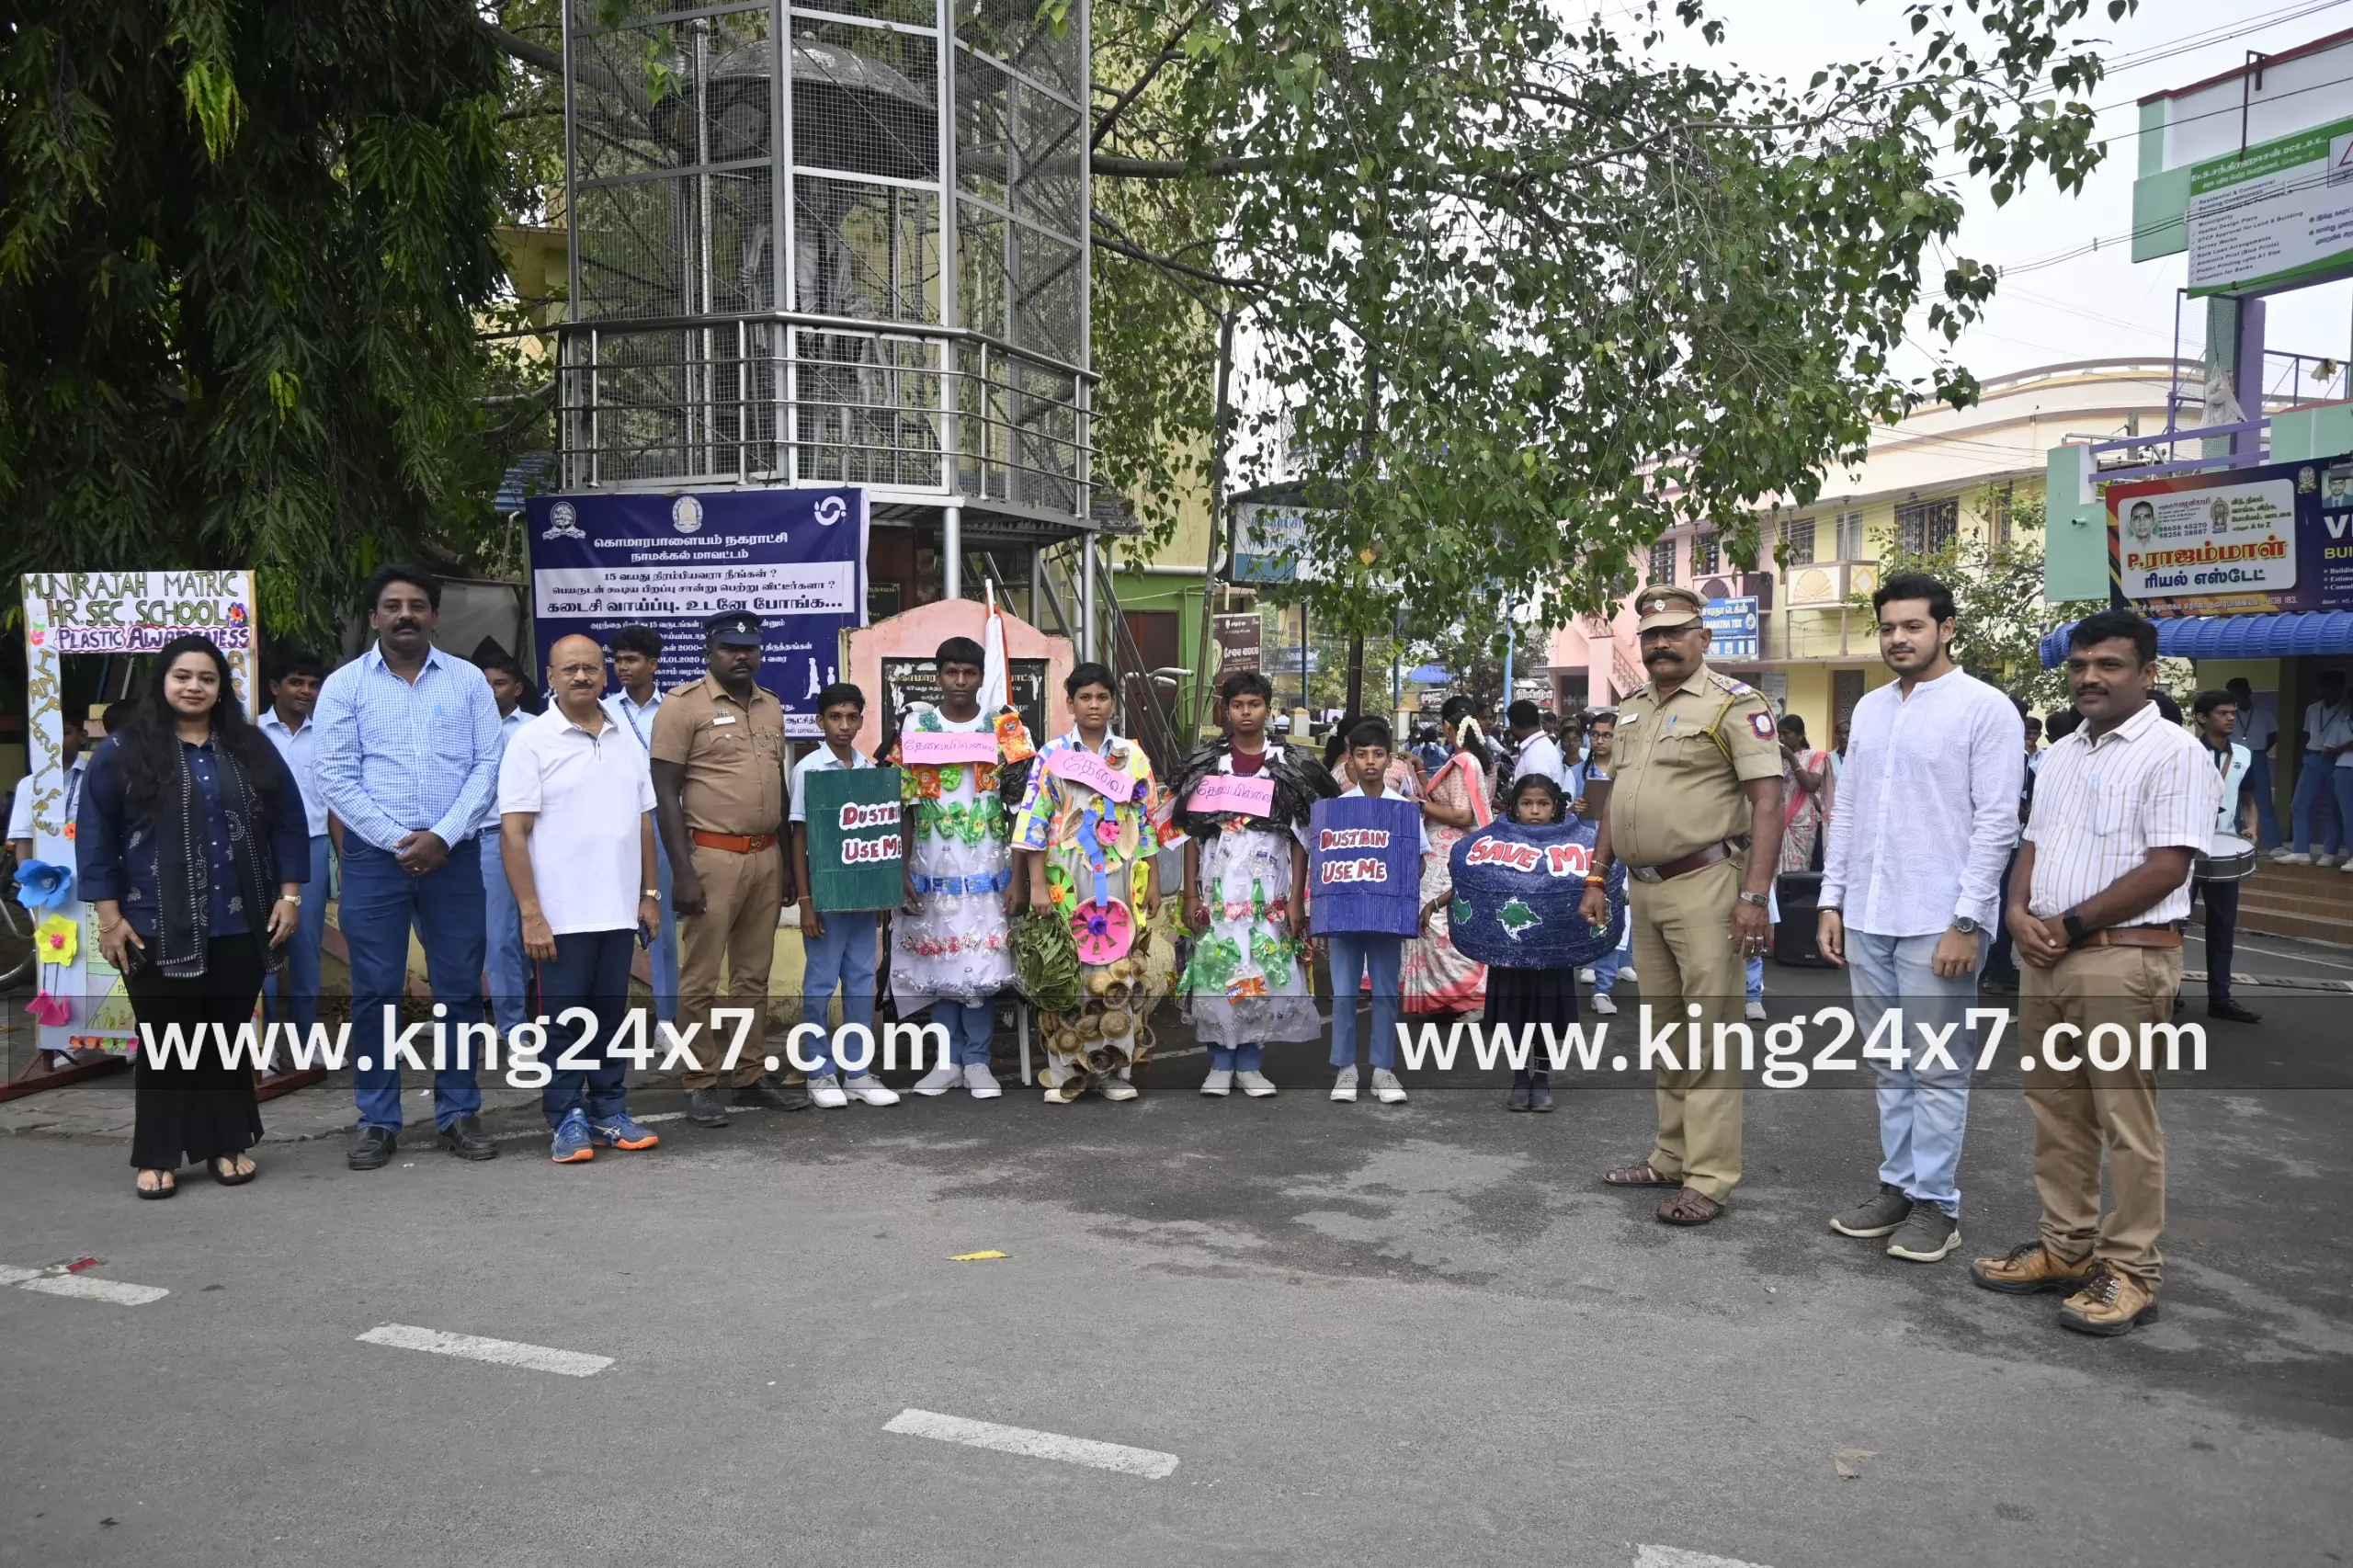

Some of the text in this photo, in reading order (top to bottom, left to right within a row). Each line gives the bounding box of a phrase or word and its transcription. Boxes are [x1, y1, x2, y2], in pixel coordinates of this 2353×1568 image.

[2199, 191, 2232, 204] Residential
[2214, 227, 2242, 239] Approval
[2254, 220, 2268, 229] Land
[2276, 210, 2303, 223] Building
[2241, 216, 2258, 224] Plans
[2198, 243, 2218, 251] Survey
[2213, 246, 2228, 255] Loan
[2229, 236, 2271, 250] Arrangements
[2197, 255, 2223, 267] Ammonia
[2225, 251, 2240, 260] Print
[2217, 259, 2241, 270] Printing
[2196, 273, 2223, 281] Valuation
[2234, 263, 2254, 274] Banks
[2184, 522, 2207, 530] 45270
[594, 531, 789, 549] கொமாரபாளையம் நகராட்சி
[631, 548, 749, 562] நாமக்கல் மாவட்டம்
[2127, 535, 2288, 571] P.ராஜம்மாள்
[164, 571, 239, 597] MATRIC
[604, 573, 617, 581] 15
[620, 573, 651, 582] வயது
[653, 570, 722, 584] நிரம்பியவரா
[724, 568, 767, 580] நீங்கள்
[2144, 567, 2266, 589] ரியல் எஸ்டேட்
[551, 585, 605, 596] பெயருடன்
[607, 586, 640, 595] கூடிய
[642, 584, 676, 595] பிறப்பு
[678, 582, 718, 594] சான்று
[720, 581, 760, 593] பெற்று
[761, 580, 825, 591] விட்டீர்களா
[547, 594, 843, 614] கடைசி வாய்ப்பு. உடனே போங்க...
[59, 629, 124, 649] PLASTIC
[767, 655, 788, 664] வரை
[1063, 754, 1125, 795] தேவை
[1321, 830, 1388, 850] DUSTBIN
[845, 841, 880, 861] USE
[1468, 836, 1539, 869] SAVE
[1323, 858, 1386, 881] USE ME
